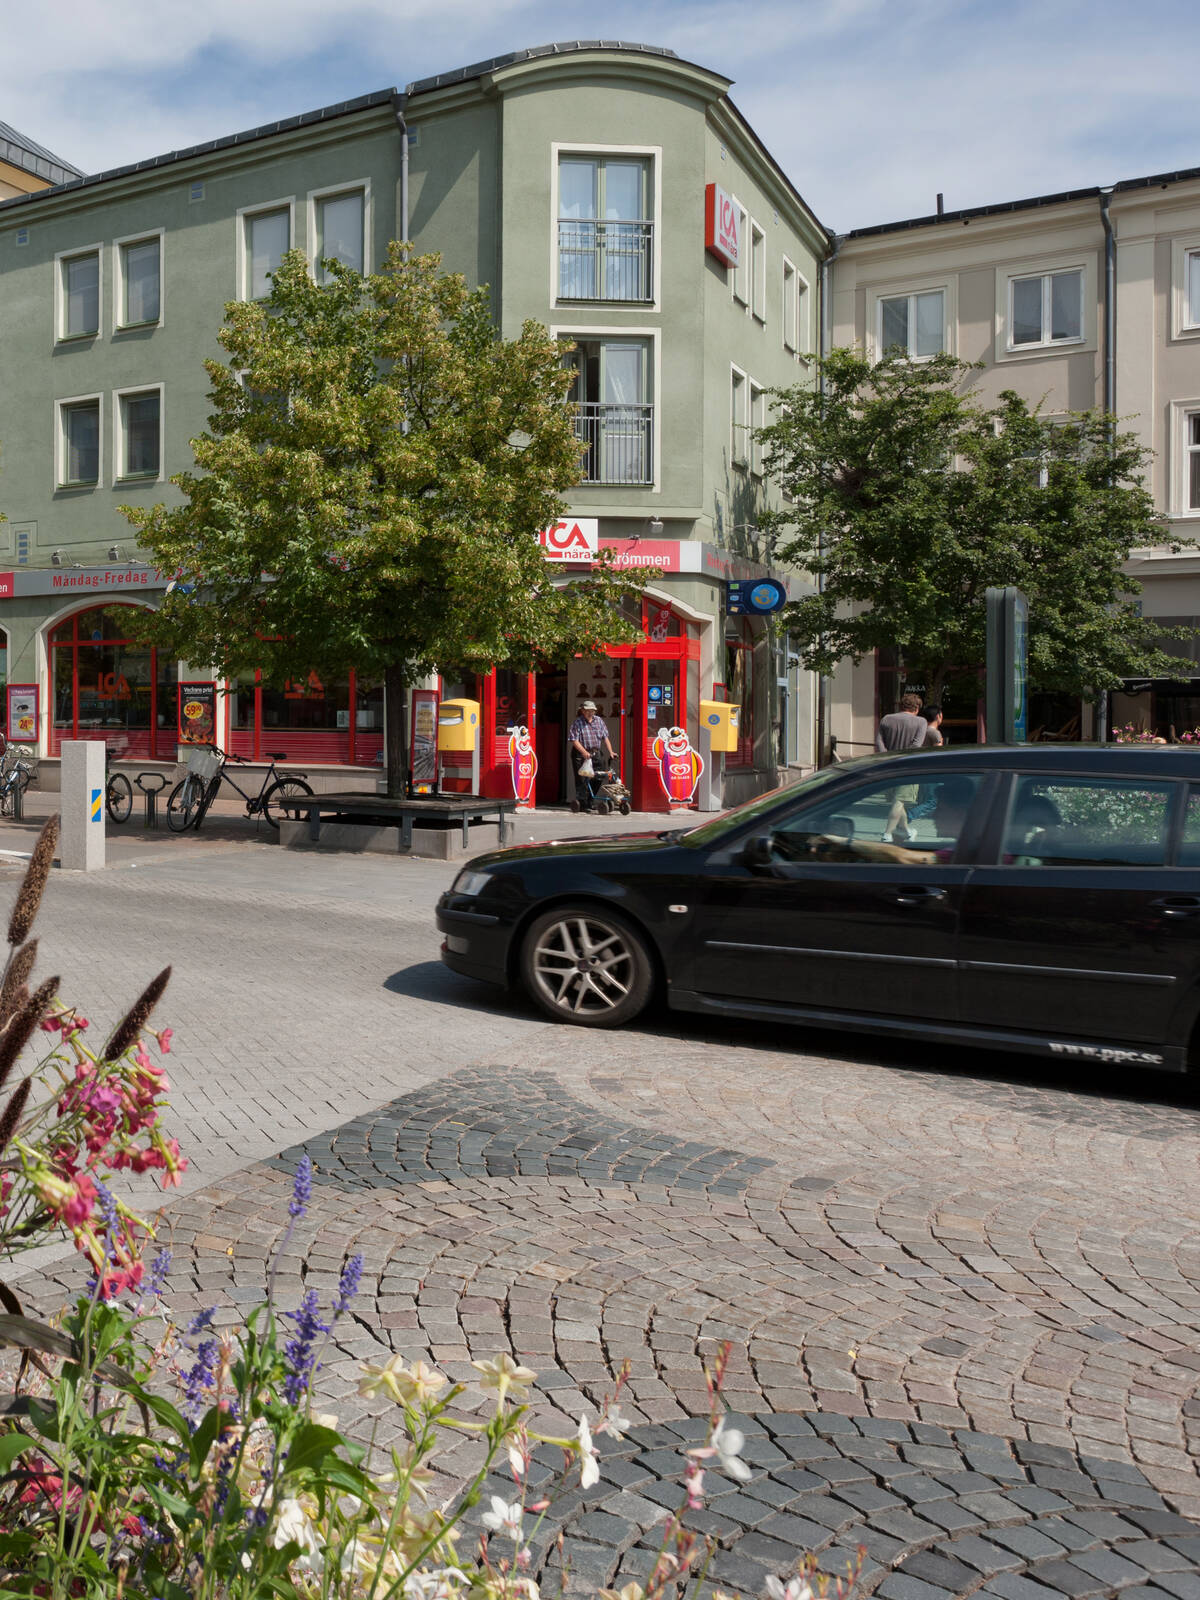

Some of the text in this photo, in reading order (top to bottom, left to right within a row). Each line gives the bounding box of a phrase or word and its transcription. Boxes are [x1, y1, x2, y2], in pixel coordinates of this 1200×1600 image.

[720, 194, 738, 247] ICA
[540, 522, 590, 549] ICA
[564, 549, 591, 559] nära
[52, 569, 148, 587] Måndag-Fredag
[98, 671, 131, 692] ICA
